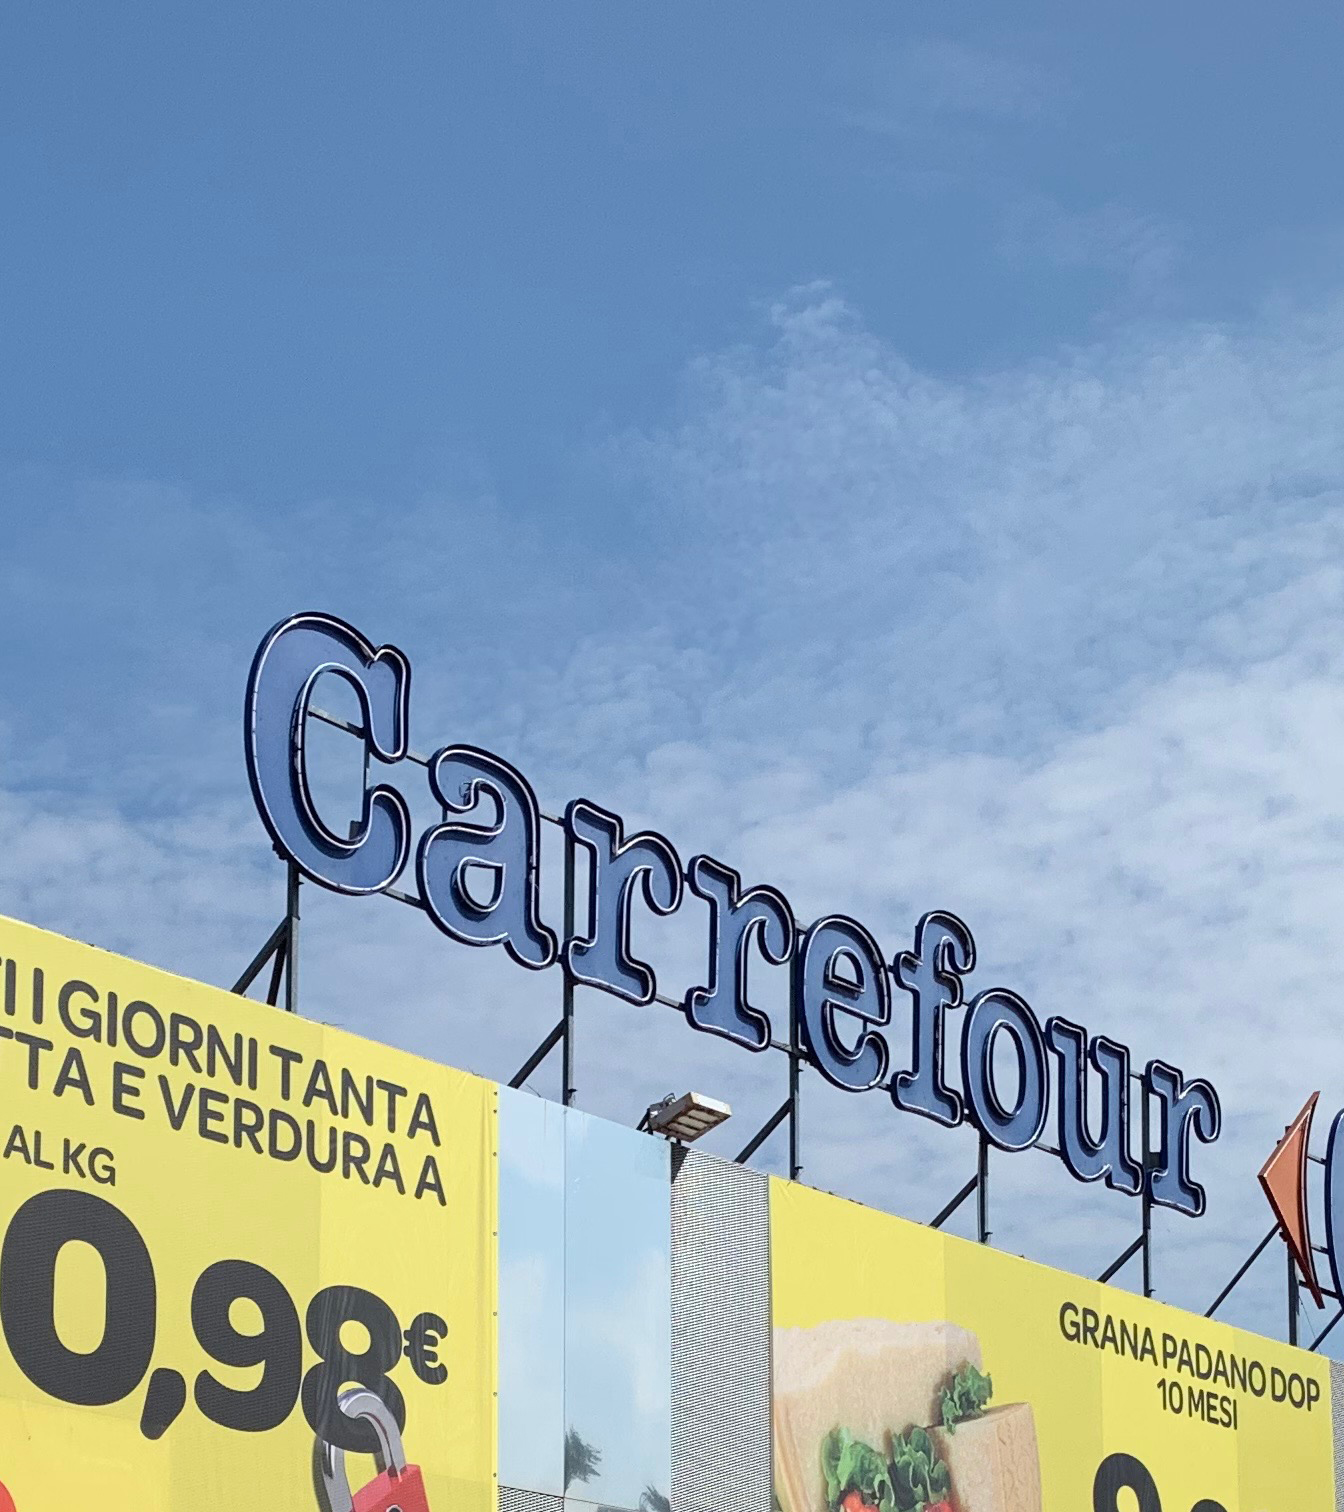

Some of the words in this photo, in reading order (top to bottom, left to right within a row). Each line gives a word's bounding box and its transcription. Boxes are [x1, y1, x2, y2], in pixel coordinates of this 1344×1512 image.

[244, 608, 1222, 1218] Carrefour
[32, 966, 44, 1025] I
[58, 980, 258, 1092] GIORNI
[269, 1044, 442, 1147] TANTA
[3, 1124, 55, 1170] AL
[62, 1140, 117, 1187] KG
[112, 1060, 146, 1121] E
[157, 1073, 406, 1196] VERDURA
[414, 1152, 447, 1207] A
[1059, 1301, 1159, 1366] GRANA
[1162, 1333, 1267, 1397] PADANO
[1271, 1363, 1320, 1411] DOP
[1157, 1377, 1185, 1414] 10
[1188, 1386, 1238, 1430] MESI
